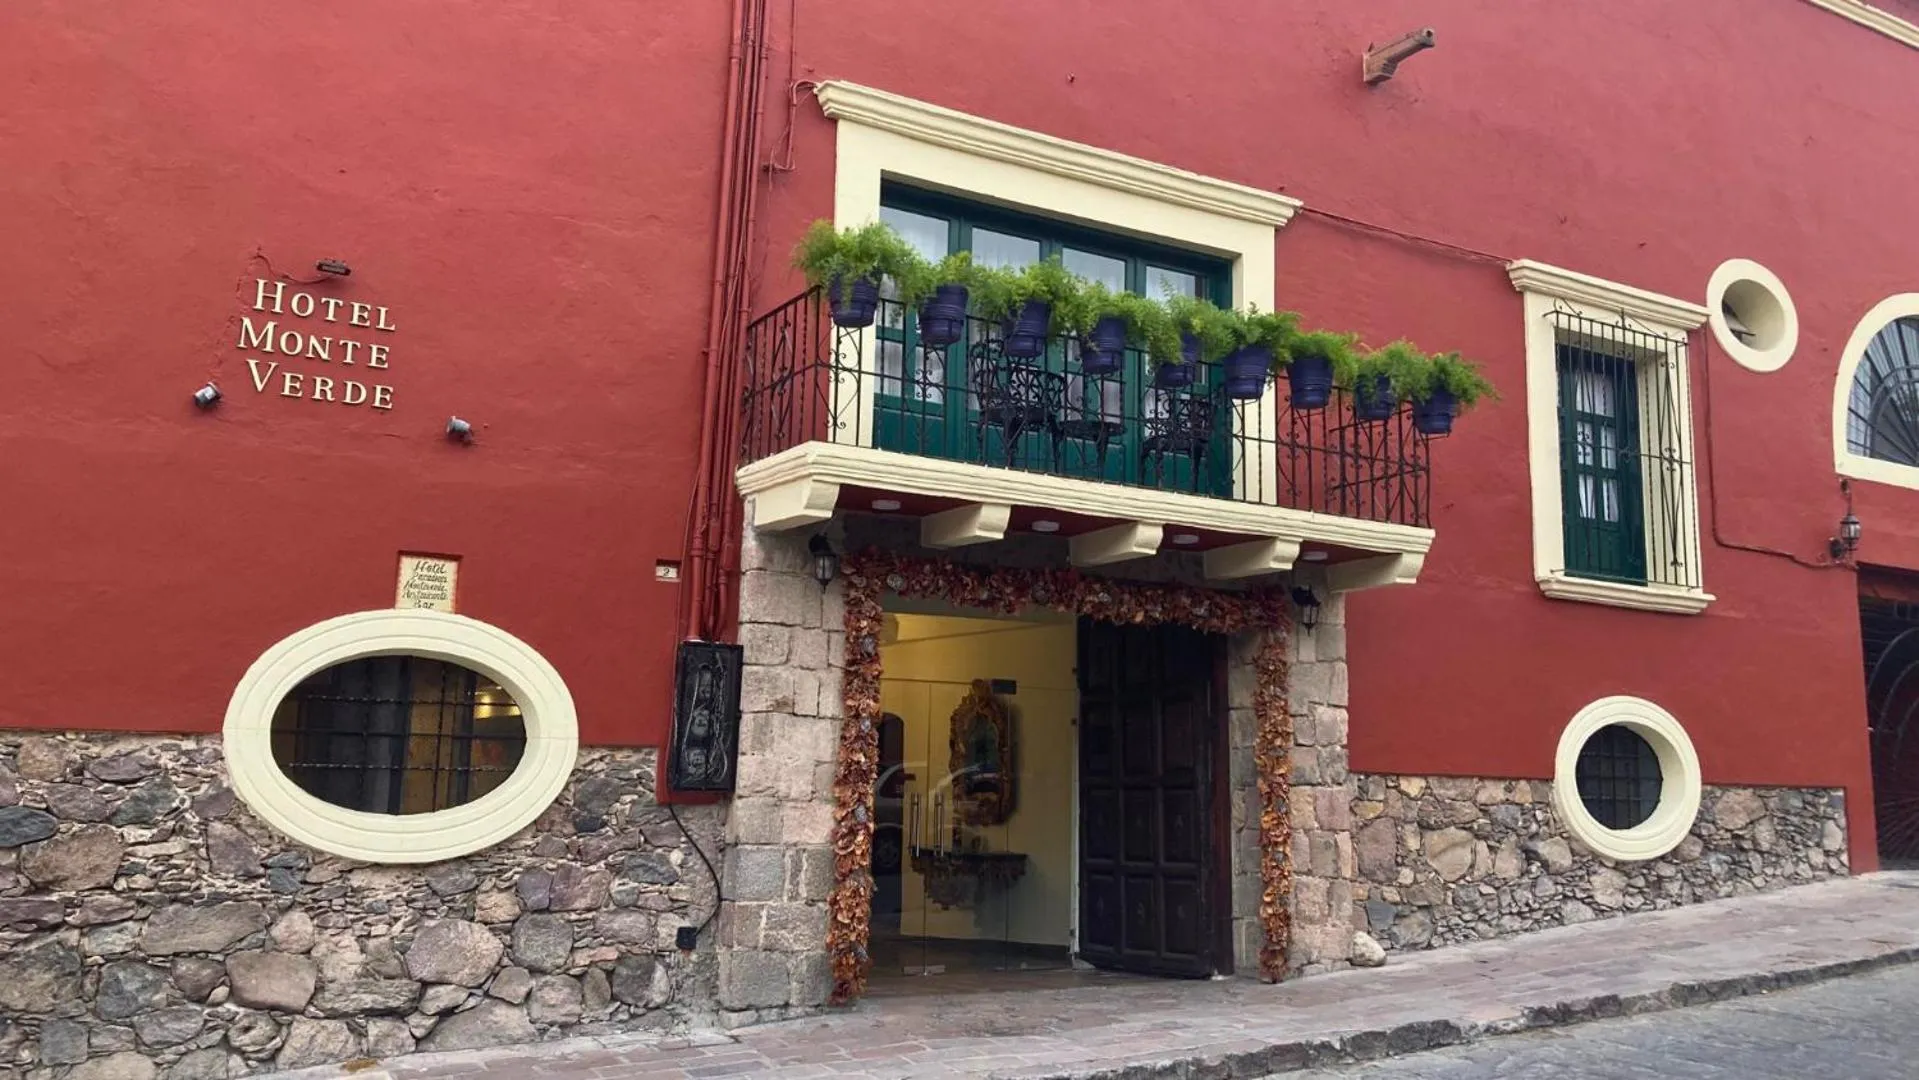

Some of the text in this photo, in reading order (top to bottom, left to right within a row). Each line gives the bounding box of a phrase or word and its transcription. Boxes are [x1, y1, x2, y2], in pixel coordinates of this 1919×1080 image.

[254, 279, 396, 331] HOTEL
[237, 316, 390, 369] MONTE
[246, 359, 394, 410] VERDE
